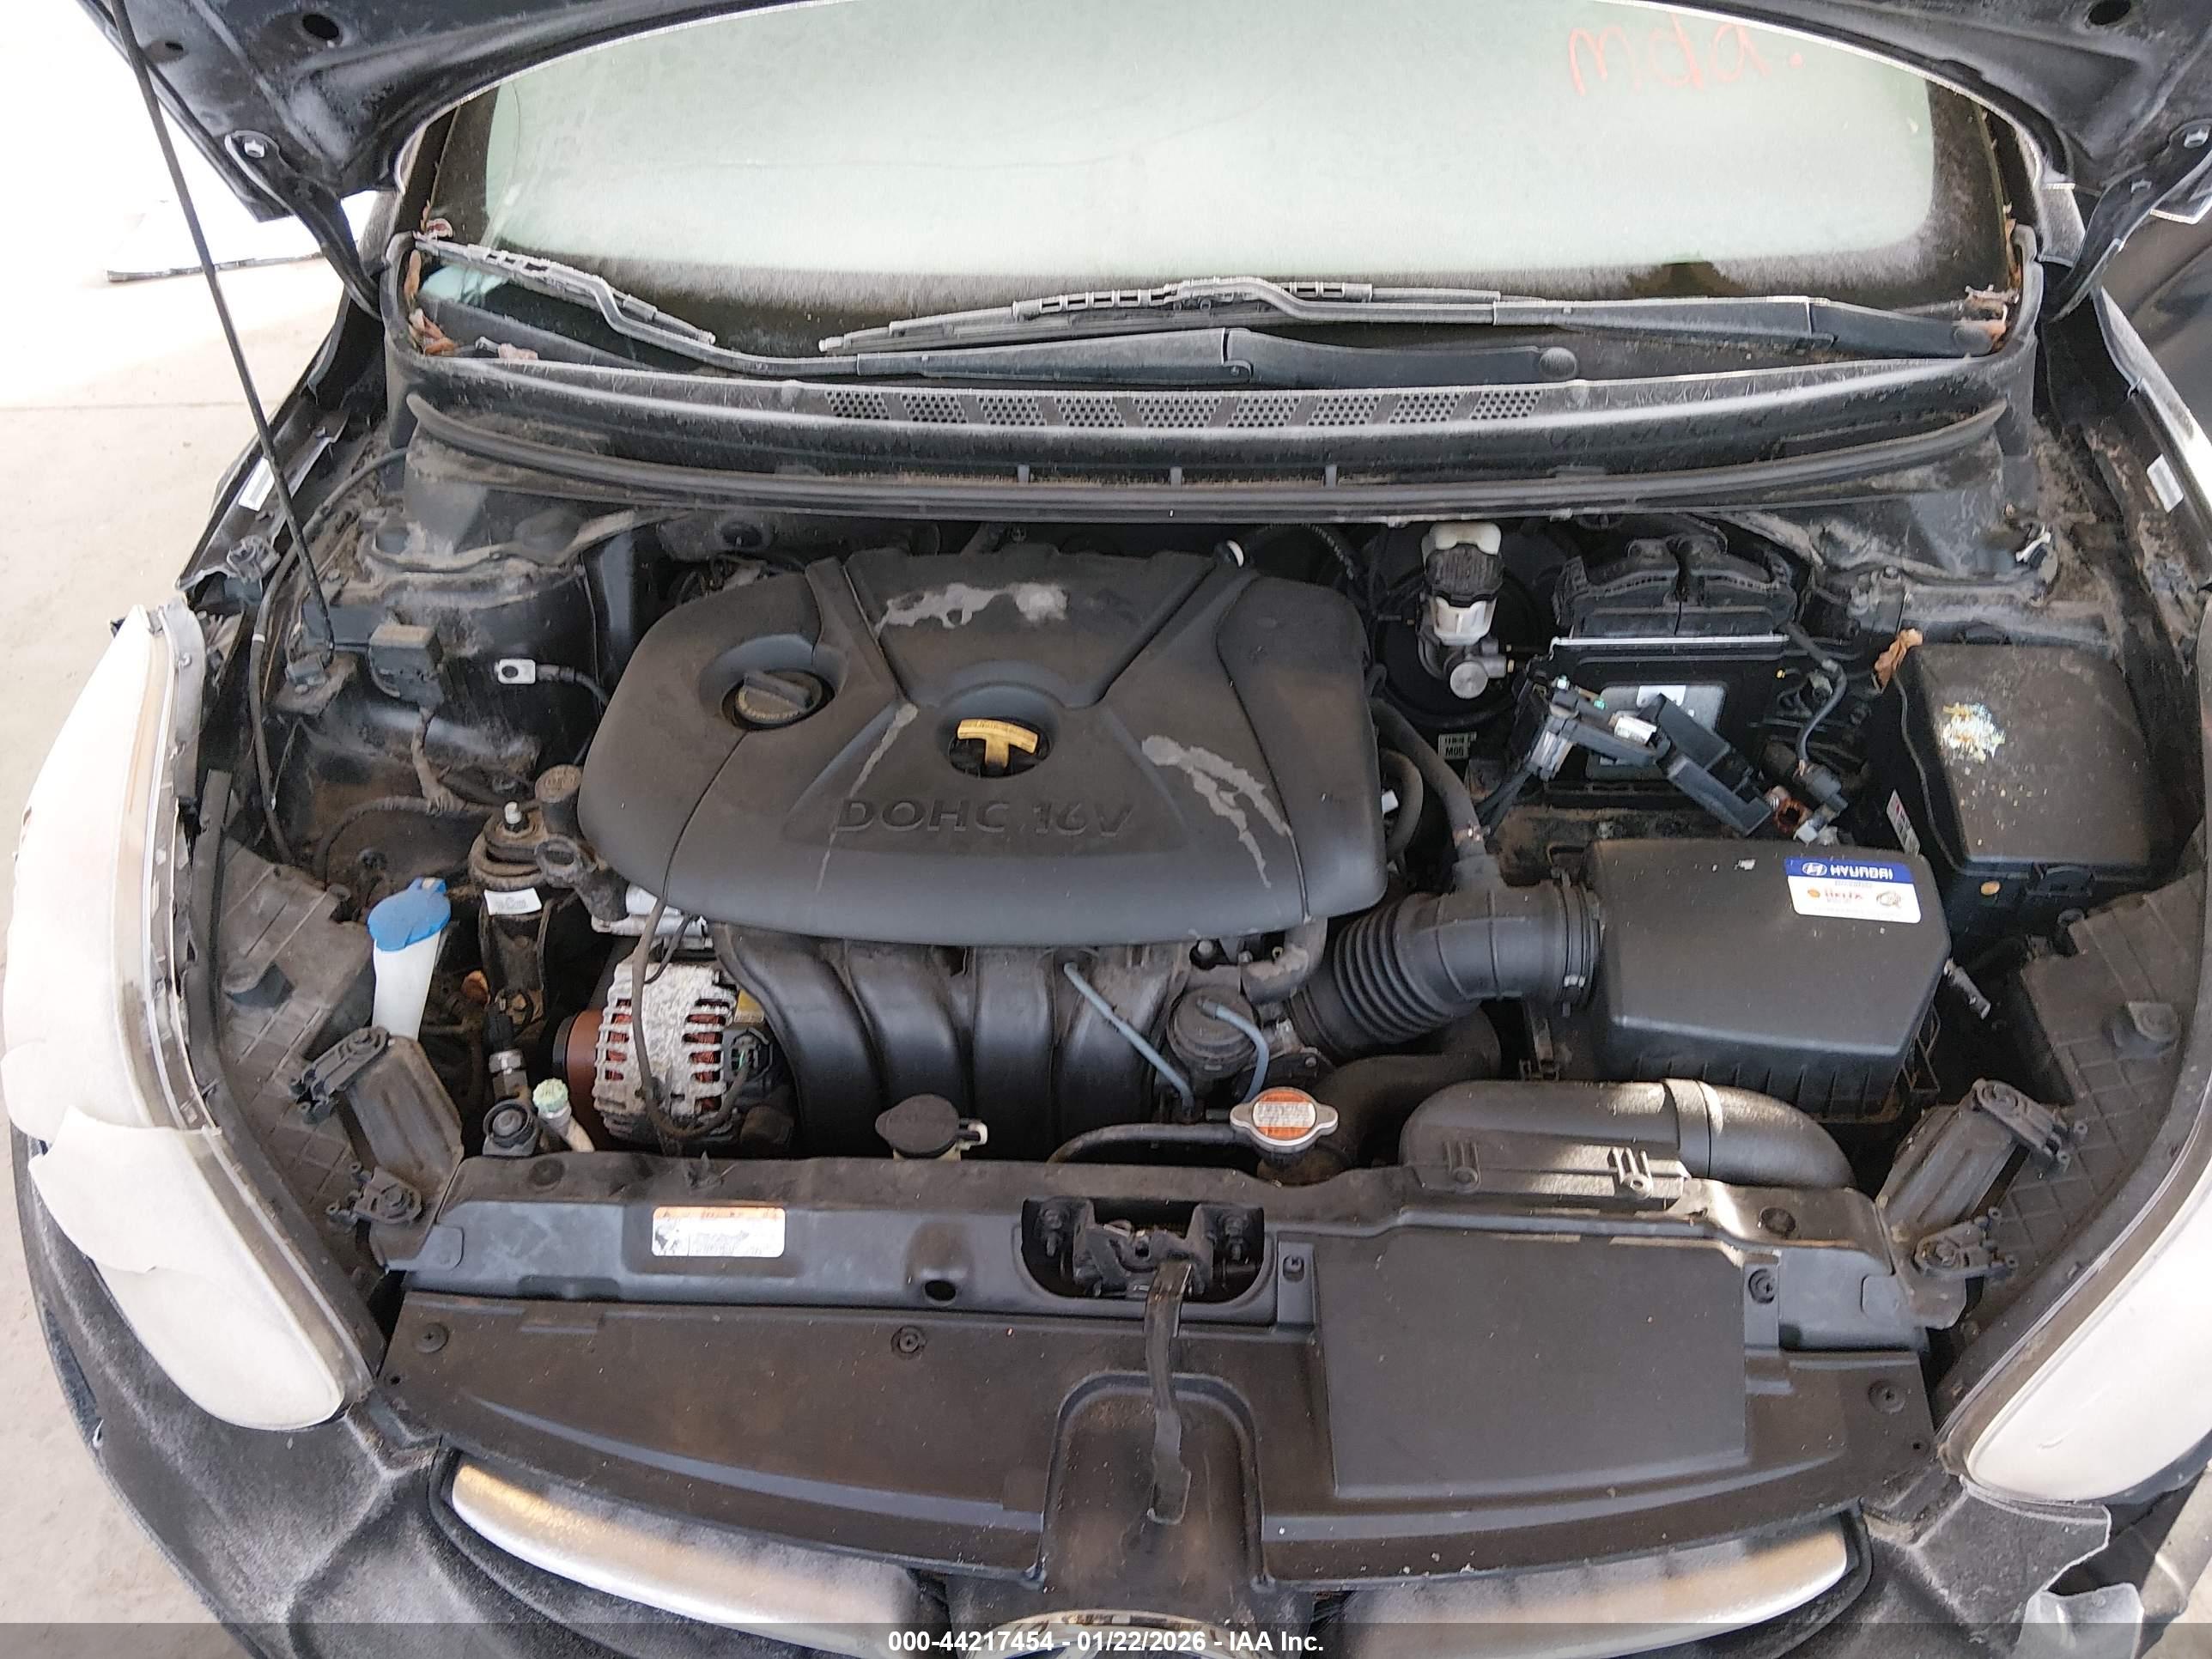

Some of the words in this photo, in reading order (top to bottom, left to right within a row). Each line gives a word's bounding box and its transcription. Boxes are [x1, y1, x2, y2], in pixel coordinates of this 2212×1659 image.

[836, 799, 1011, 833] DOHC
[1031, 802, 1134, 837] 16V
[1830, 864, 1893, 880] HYUNDAI
